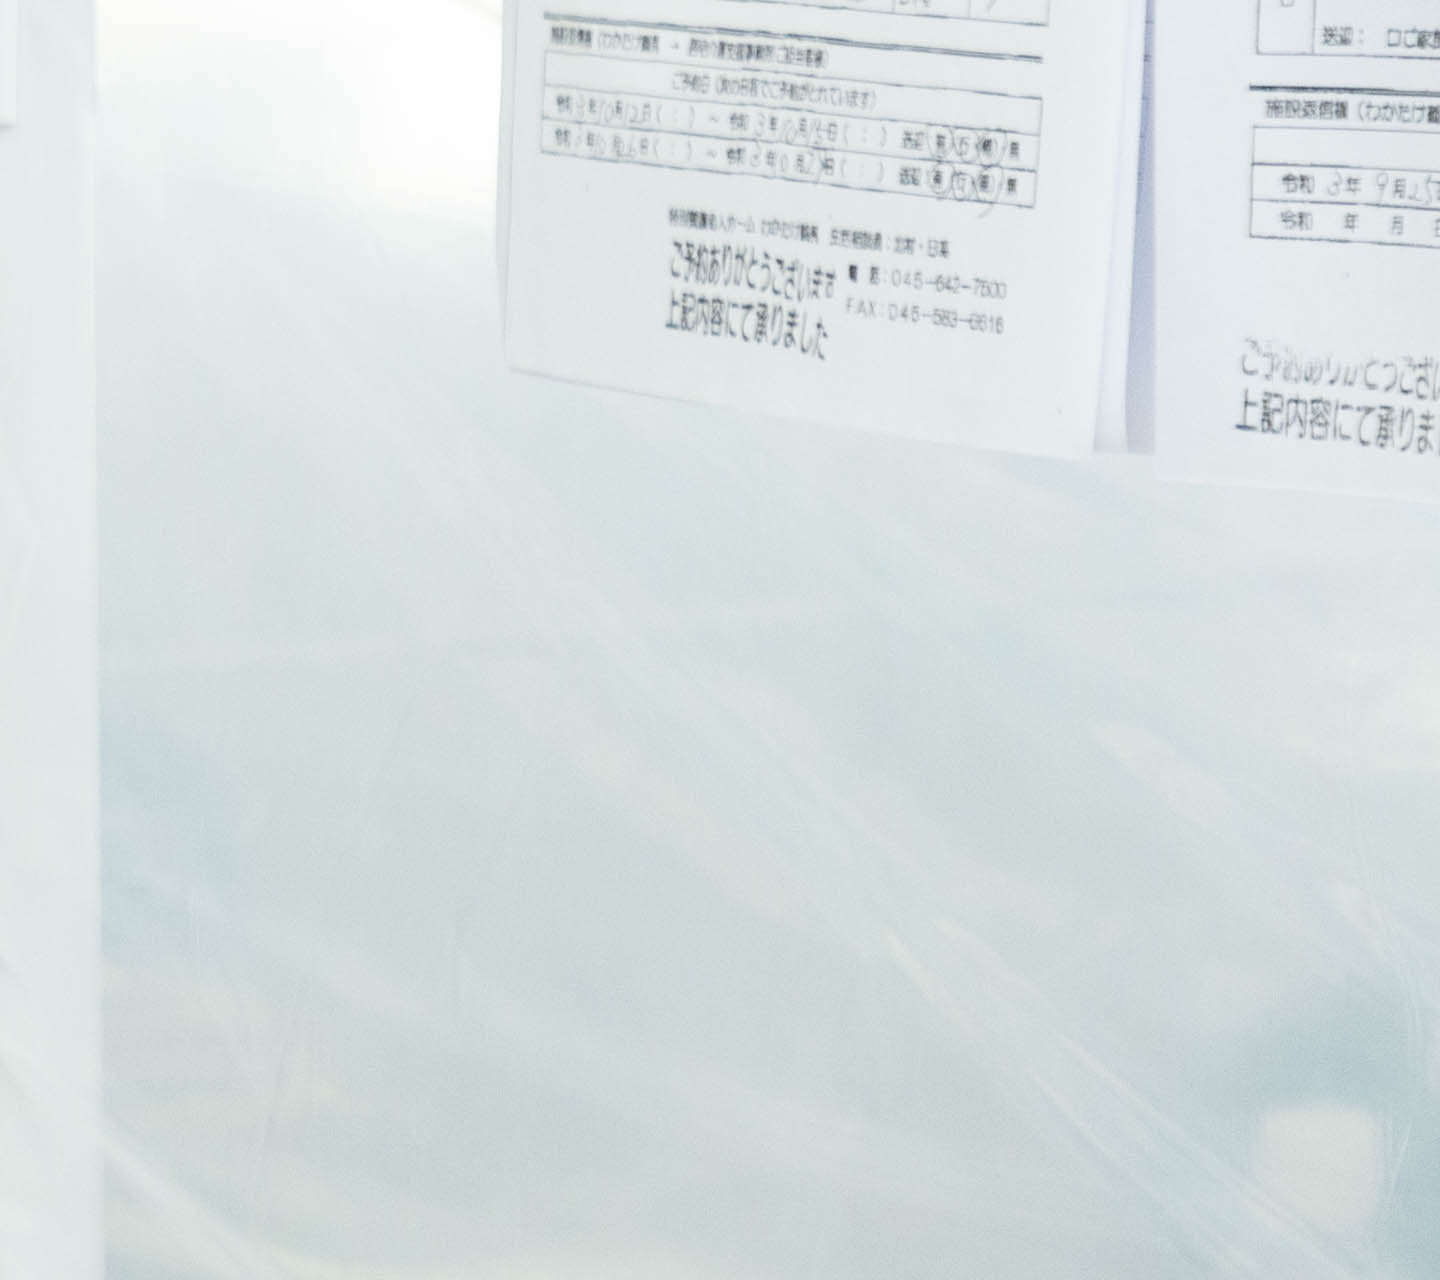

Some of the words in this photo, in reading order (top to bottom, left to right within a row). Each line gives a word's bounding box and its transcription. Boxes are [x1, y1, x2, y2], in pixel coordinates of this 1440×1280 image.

[665, 288, 828, 361] 上記内容にて承りました
[1235, 387, 1440, 455] 上記内容にて承りま
